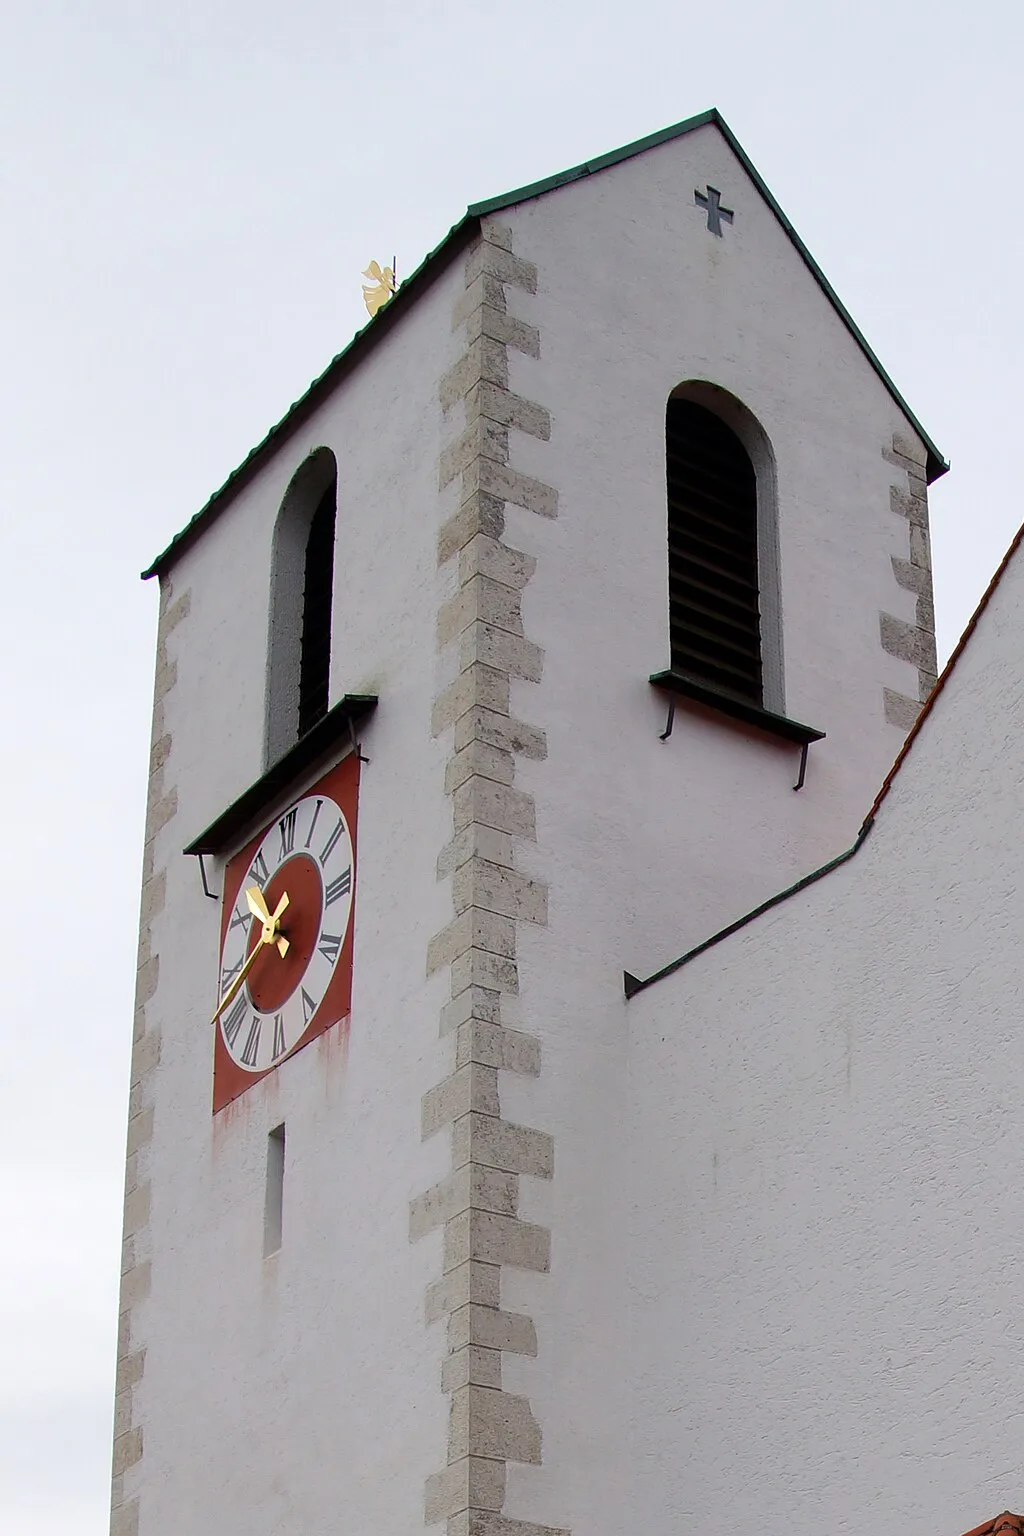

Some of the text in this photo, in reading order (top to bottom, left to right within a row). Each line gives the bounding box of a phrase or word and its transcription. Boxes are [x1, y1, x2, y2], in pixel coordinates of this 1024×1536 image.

[278, 807, 298, 863] XII
[305, 799, 323, 848] I
[319, 817, 345, 868] II
[248, 848, 270, 890] XI
[325, 865, 351, 910] III
[229, 905, 251, 935] X
[317, 931, 343, 966] IV
[223, 991, 247, 1049] VIII
[300, 985, 317, 1026] V
[240, 1016, 262, 1066] VII
[271, 1013, 286, 1062] VI
